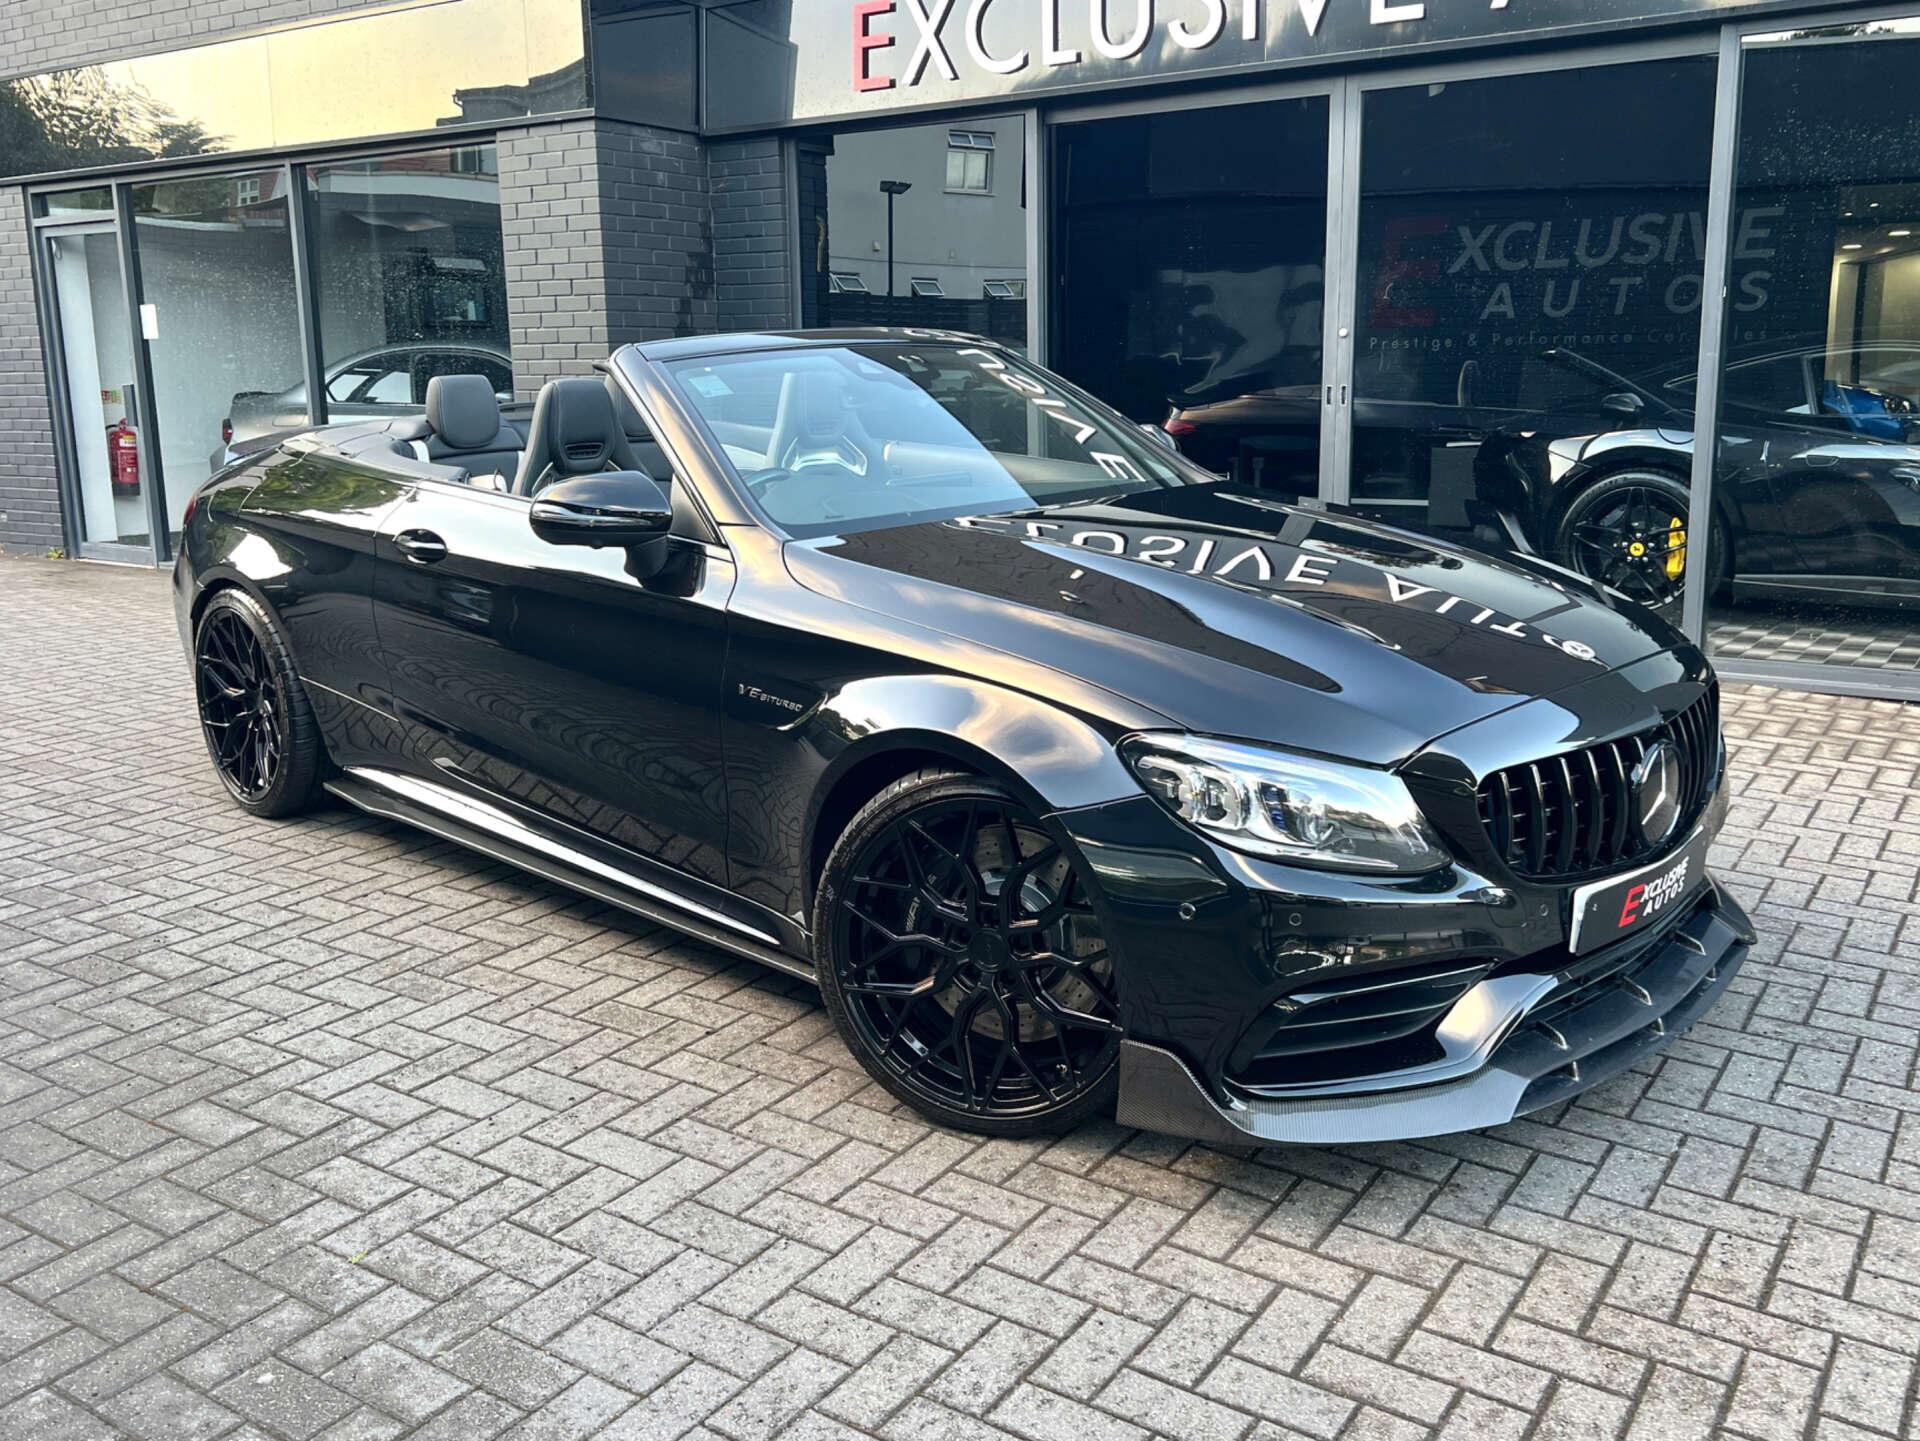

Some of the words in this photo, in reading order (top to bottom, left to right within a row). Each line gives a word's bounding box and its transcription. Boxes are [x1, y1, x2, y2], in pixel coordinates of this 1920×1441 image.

[852, 0, 1427, 92] EXCLUS
[1479, 270, 1774, 320] AUTOS
[1369, 335, 1453, 351] Prestige
[1467, 333, 1478, 347] &
[1492, 330, 1634, 346] Performance
[1642, 875, 1686, 917] AUTOS
